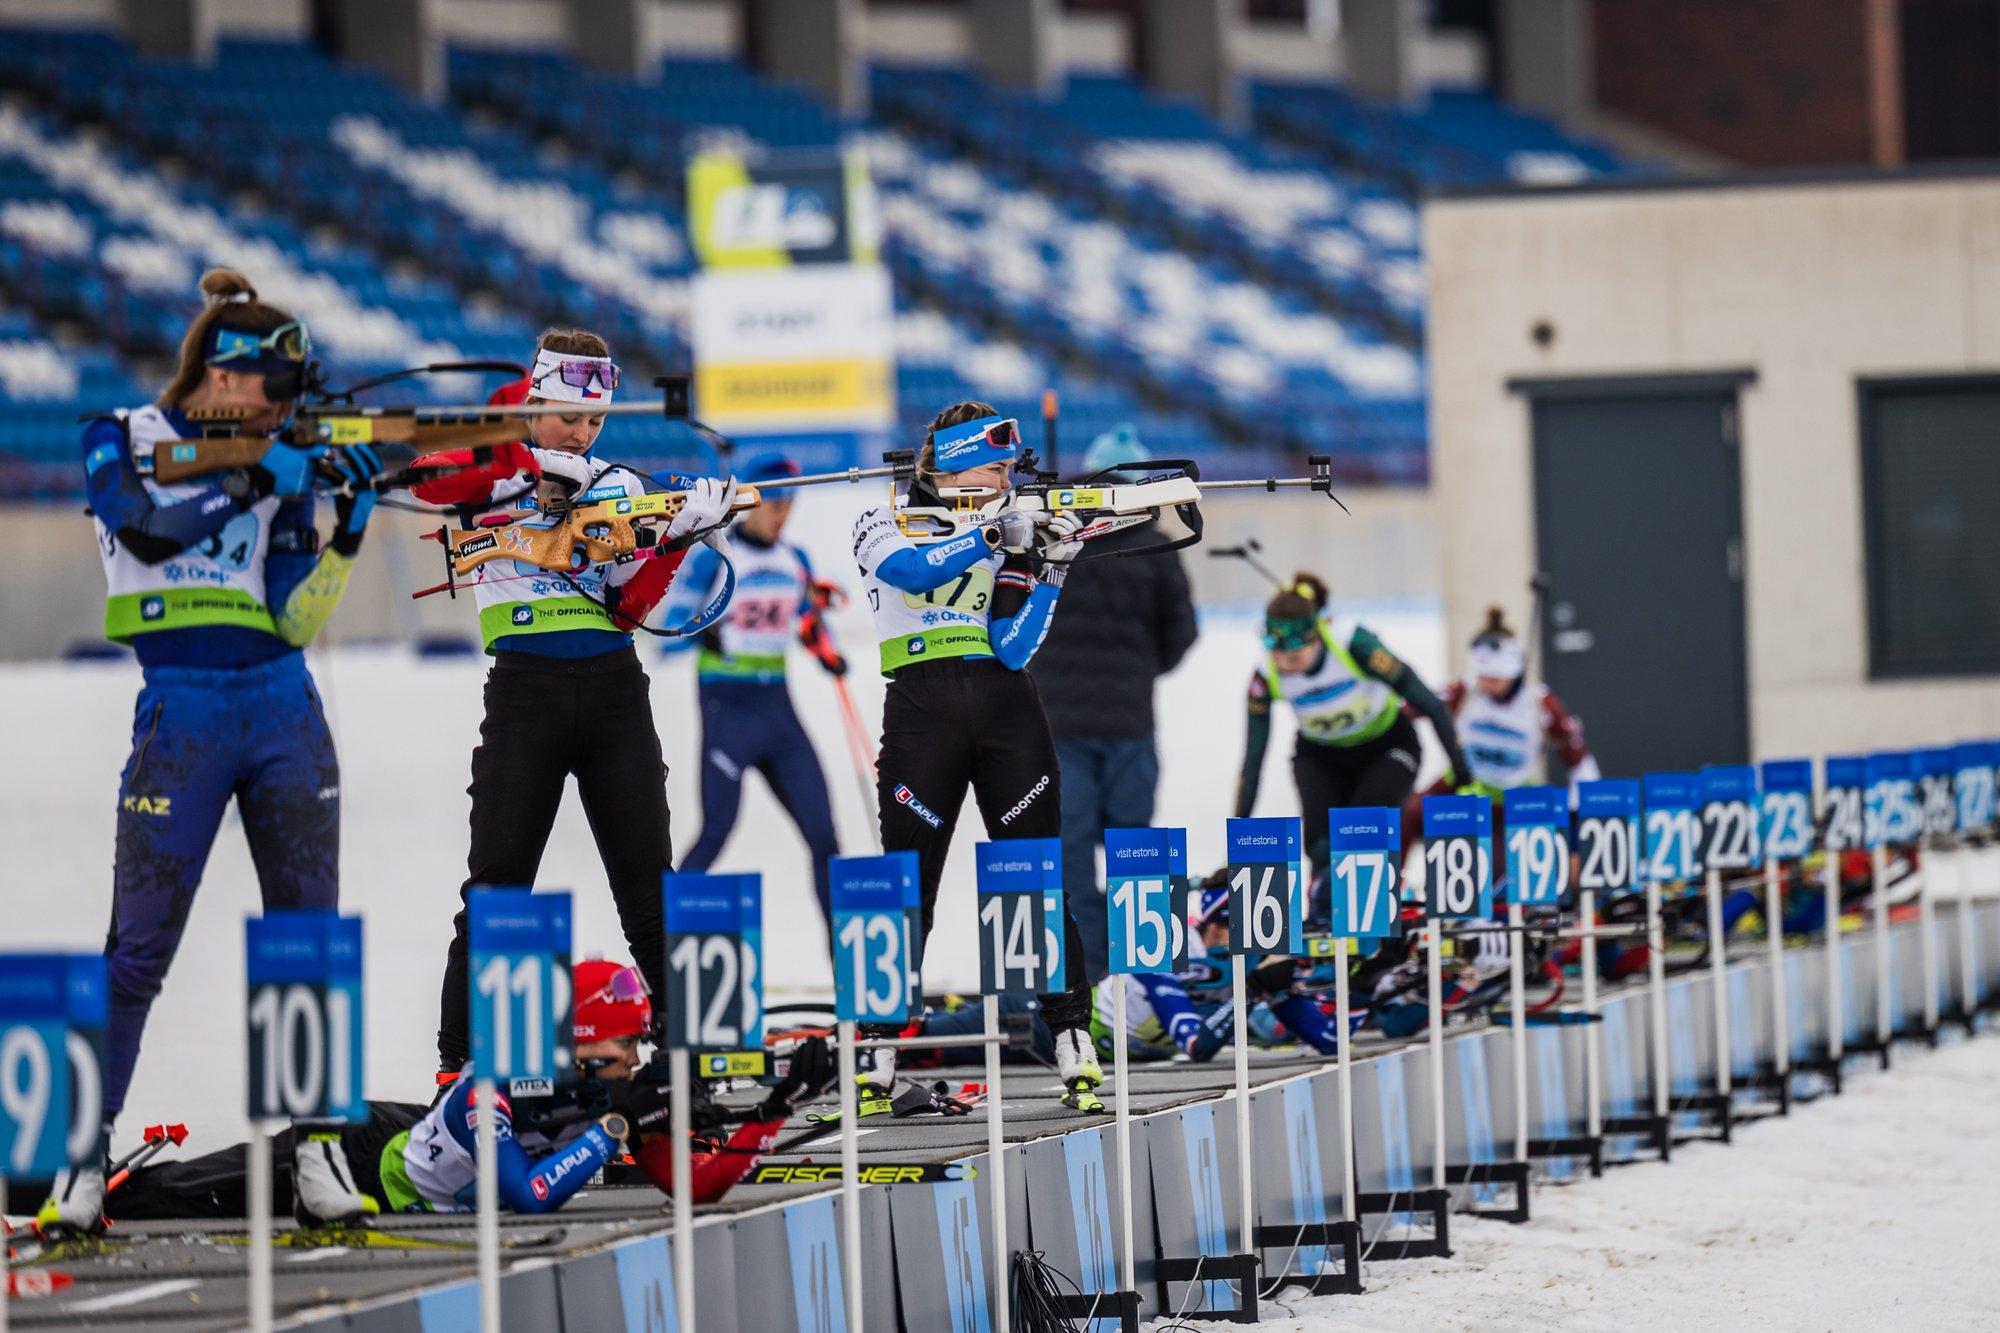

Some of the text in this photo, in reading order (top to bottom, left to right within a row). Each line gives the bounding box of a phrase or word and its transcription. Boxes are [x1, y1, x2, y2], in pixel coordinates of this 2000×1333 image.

[586, 486, 623, 499] Tipsport
[230, 540, 248, 566] 4
[942, 539, 973, 556] LAPUA
[538, 609, 555, 618] THE
[557, 608, 596, 617] OFFICIAL
[972, 592, 987, 611] 3
[930, 639, 944, 647] THE
[945, 636, 979, 644] OFFICIAL
[124, 796, 171, 816] KAZ
[908, 799, 939, 828] LAPUA
[1000, 775, 1050, 826] moomoo
[1339, 825, 1379, 835] visit estonia
[1763, 790, 1807, 858] 23
[1116, 848, 1132, 859] visit
[1132, 847, 1159, 858] estonia
[1237, 836, 1252, 846] visit
[1253, 836, 1278, 846] estonia
[1509, 825, 1556, 901] 19
[1579, 816, 1628, 889] 20
[1646, 808, 1693, 879] 21
[1703, 800, 1750, 868] 22
[1335, 853, 1385, 933] 17
[1427, 837, 1475, 915] 18
[1112, 880, 1167, 968] 15
[1231, 867, 1283, 950] 16
[839, 914, 902, 1017] 13
[980, 895, 1040, 990] 14
[476, 954, 543, 1077] 11
[670, 934, 739, 1047] 12
[251, 984, 326, 1116] 10
[0, 1024, 51, 1175] 9
[513, 1078, 550, 1092] ATEX
[545, 1146, 592, 1187] LAPUA
[756, 1167, 925, 1184] FISCHER
